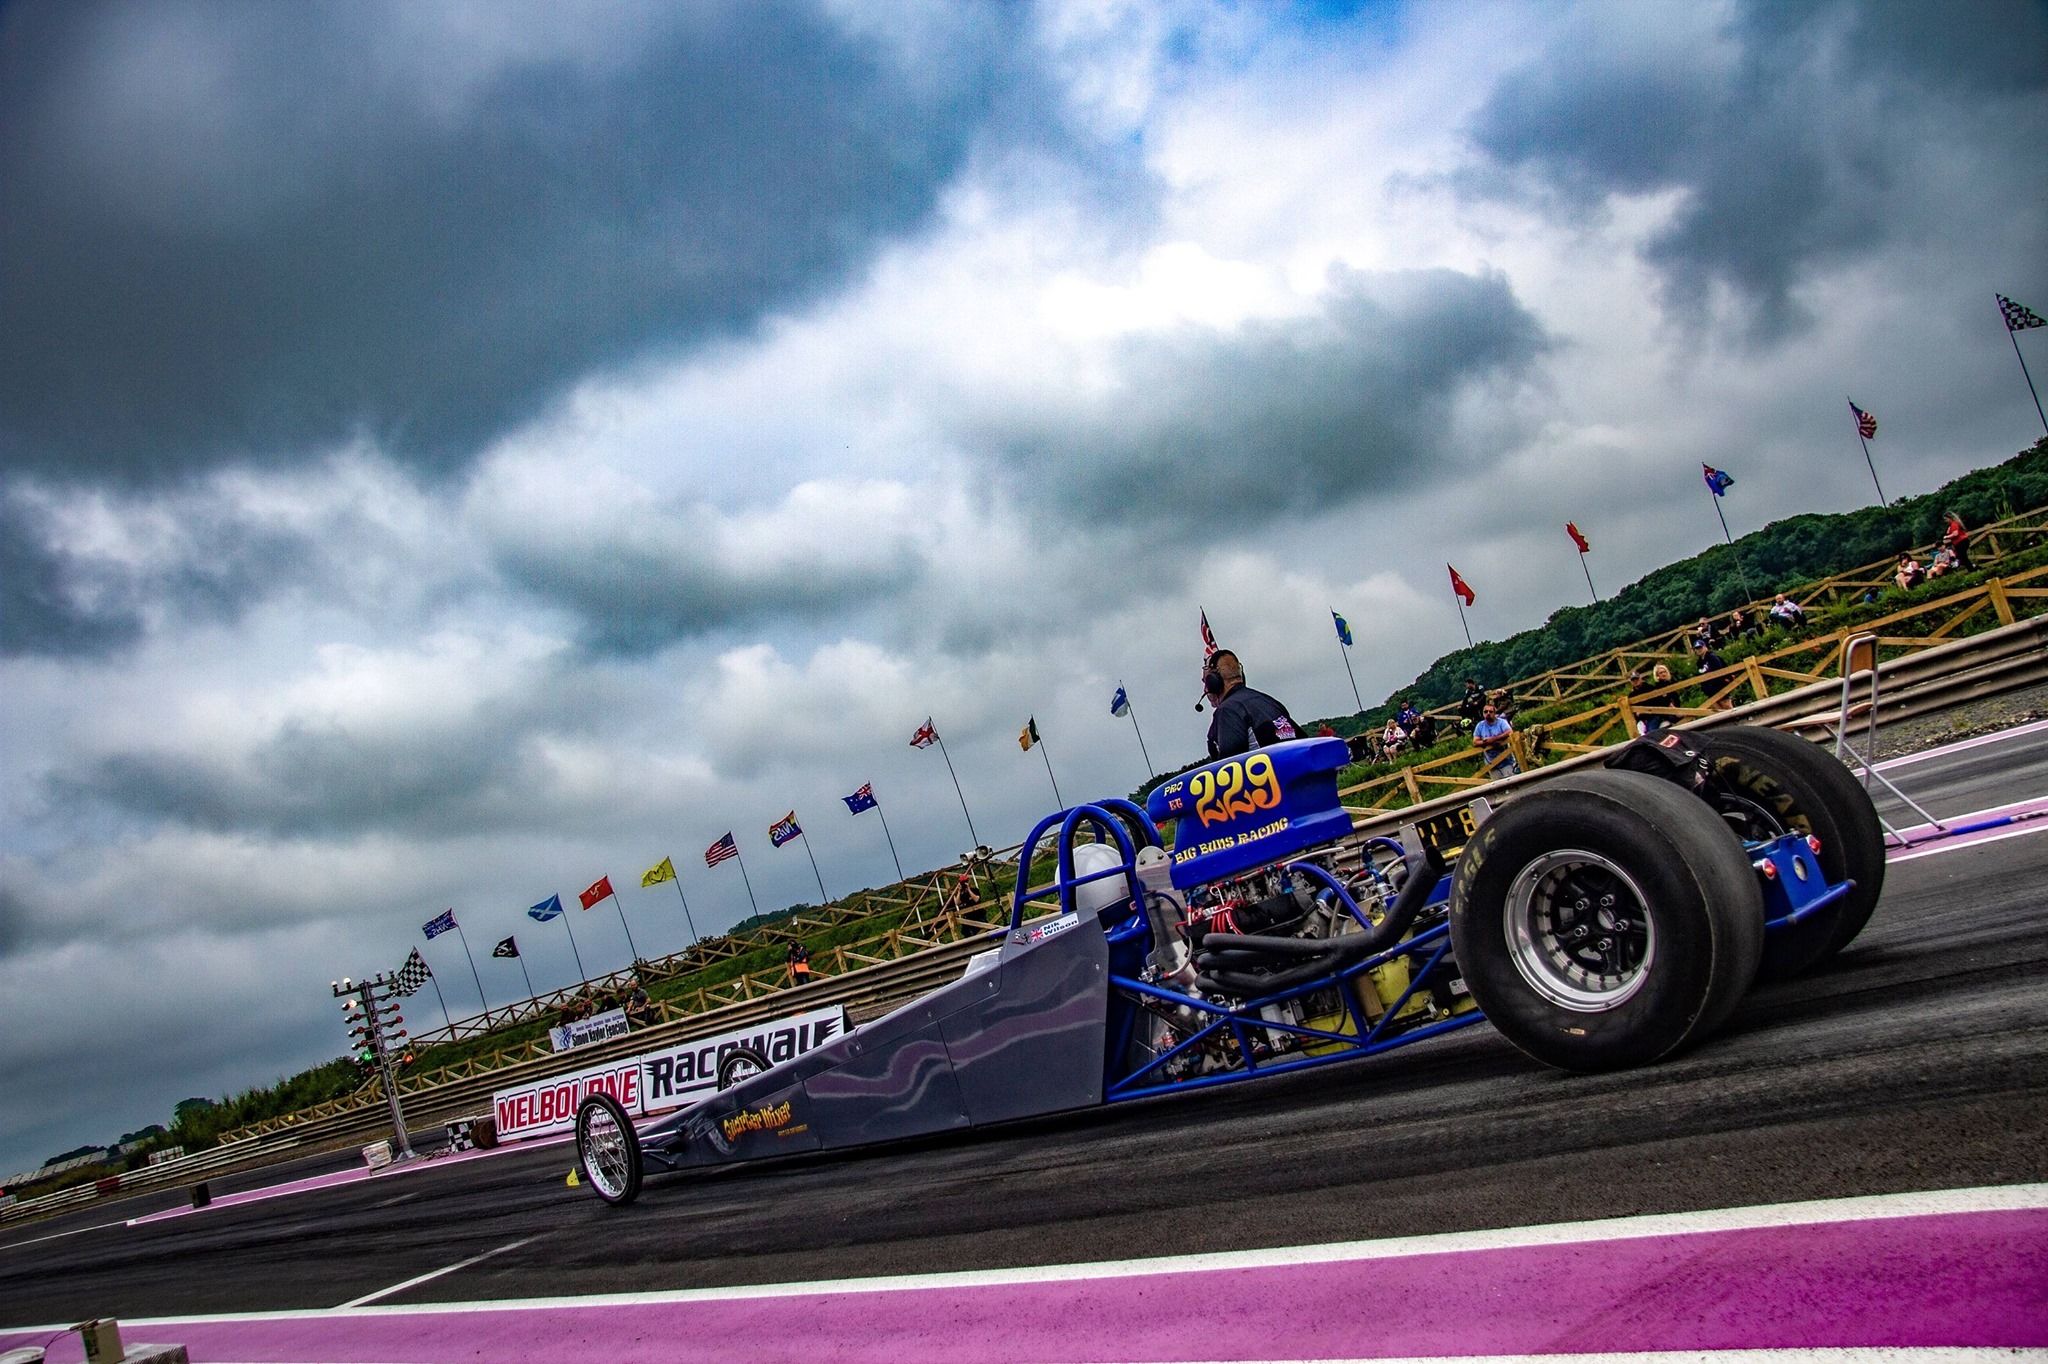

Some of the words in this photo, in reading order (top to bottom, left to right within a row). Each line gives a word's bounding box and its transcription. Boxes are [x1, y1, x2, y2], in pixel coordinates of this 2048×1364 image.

[1163, 781, 1184, 798] PRO
[1189, 753, 1282, 829] 229
[1174, 847, 1197, 865] BIG
[1200, 836, 1236, 855] BUNS
[1237, 817, 1289, 846] RACING
[1043, 921, 1060, 931] Nik
[1044, 920, 1078, 935] Wilson
